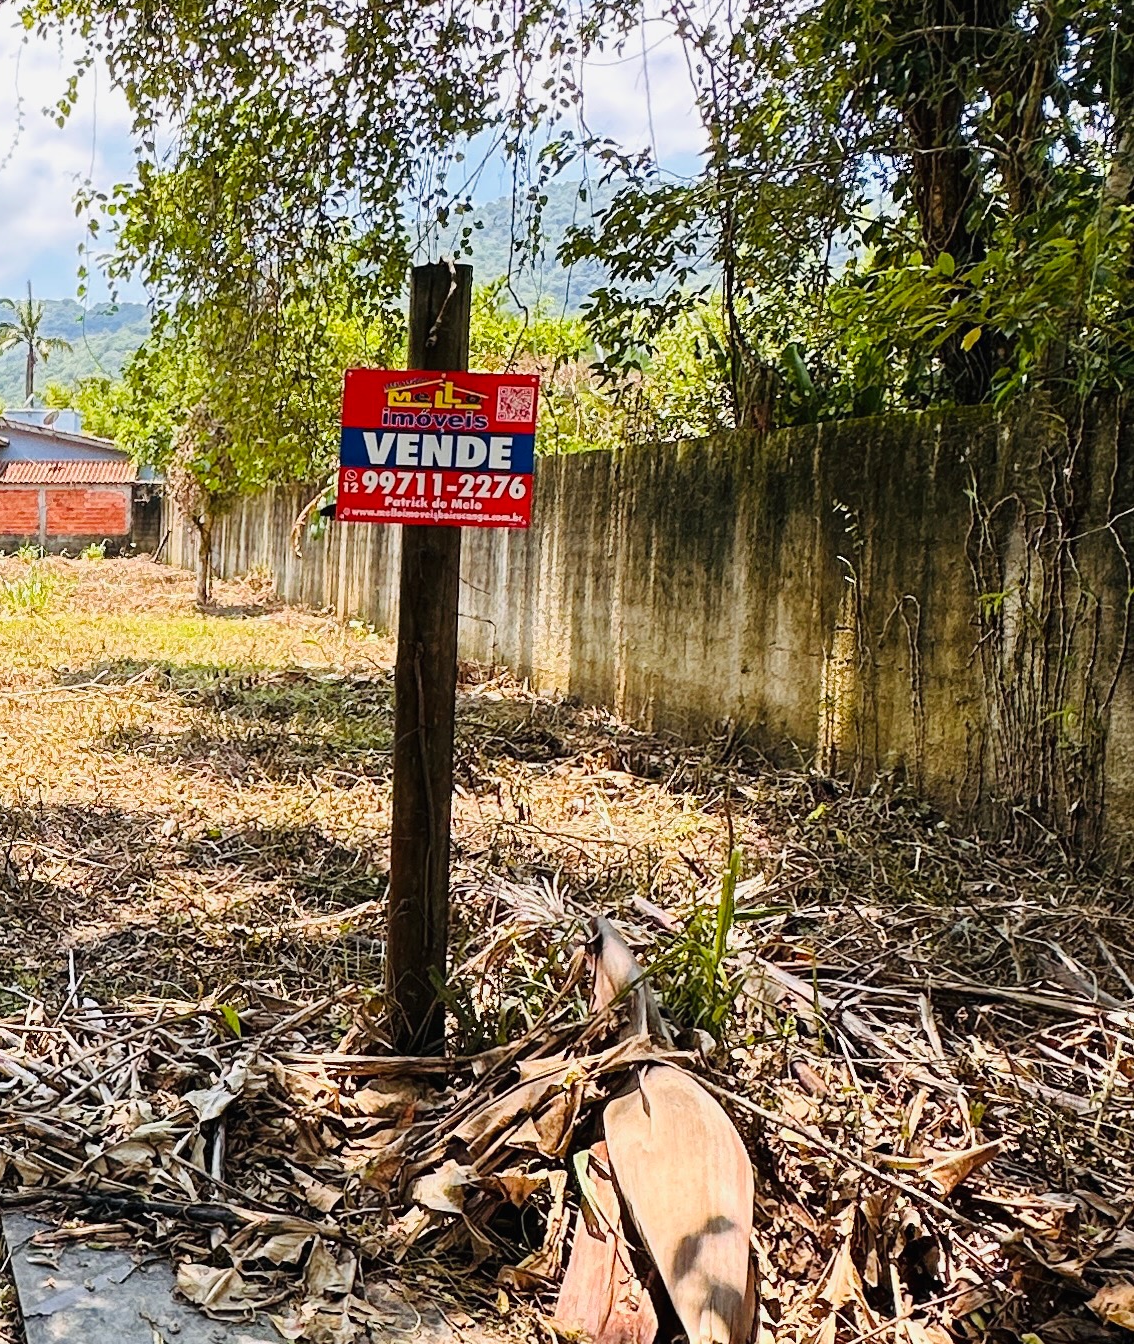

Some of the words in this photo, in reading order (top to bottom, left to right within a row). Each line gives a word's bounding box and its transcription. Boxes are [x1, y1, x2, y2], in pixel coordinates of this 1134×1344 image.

[381, 408, 489, 429] imóveis
[363, 431, 514, 470] VENDE
[343, 481, 359, 494] 12
[361, 471, 526, 499] 99711-2276
[384, 496, 428, 509] Patrick
[431, 497, 447, 510] de
[451, 499, 483, 511] Melo
